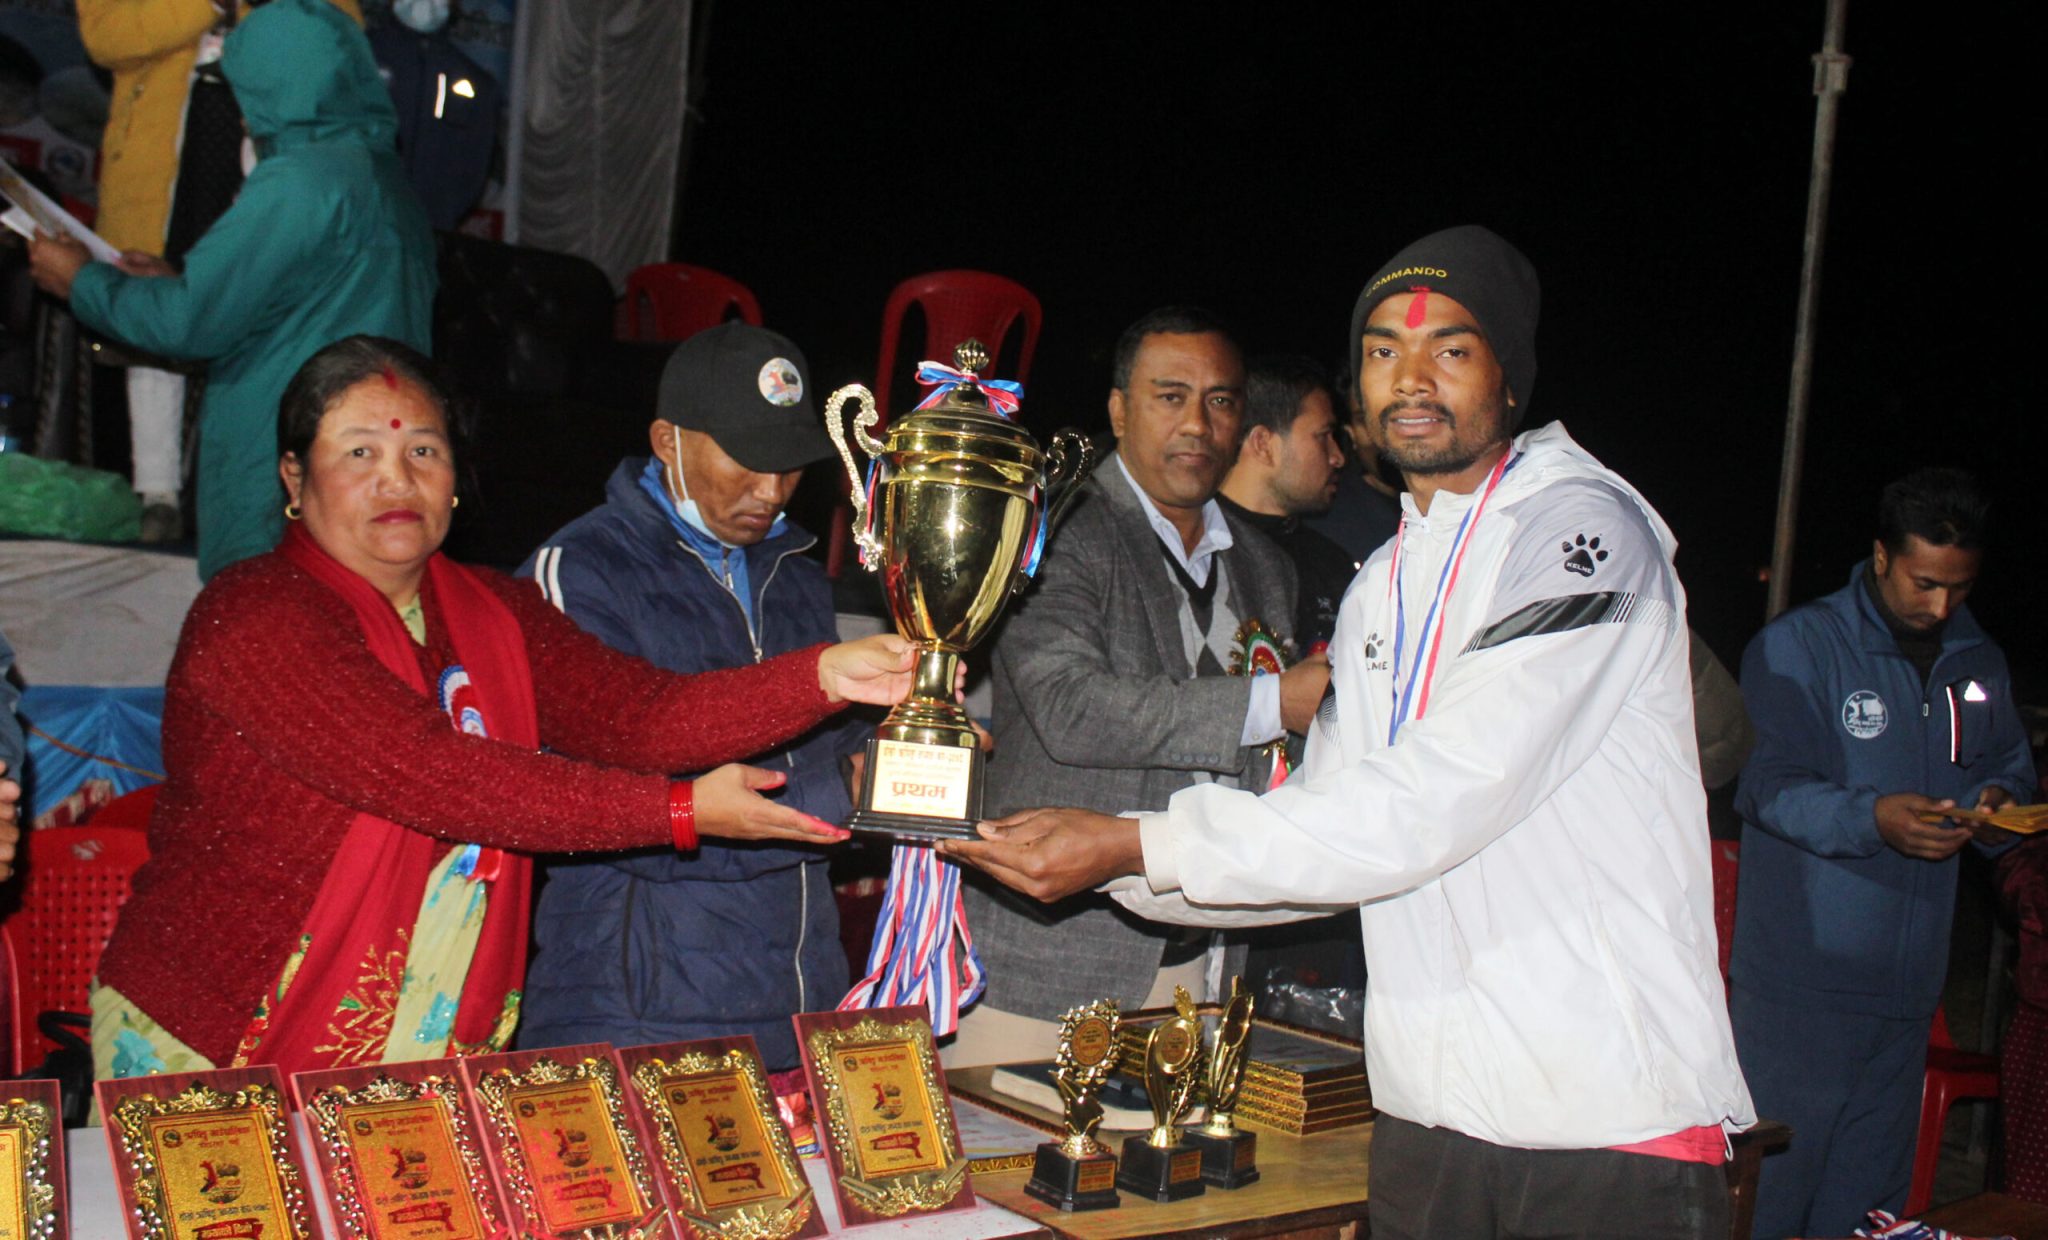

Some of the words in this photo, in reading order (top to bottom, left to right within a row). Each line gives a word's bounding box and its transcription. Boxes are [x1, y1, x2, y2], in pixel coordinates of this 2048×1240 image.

[1366, 266, 1449, 297] COMMANDO
[1566, 562, 1593, 574] KELME
[892, 781, 948, 800] प्रथम
